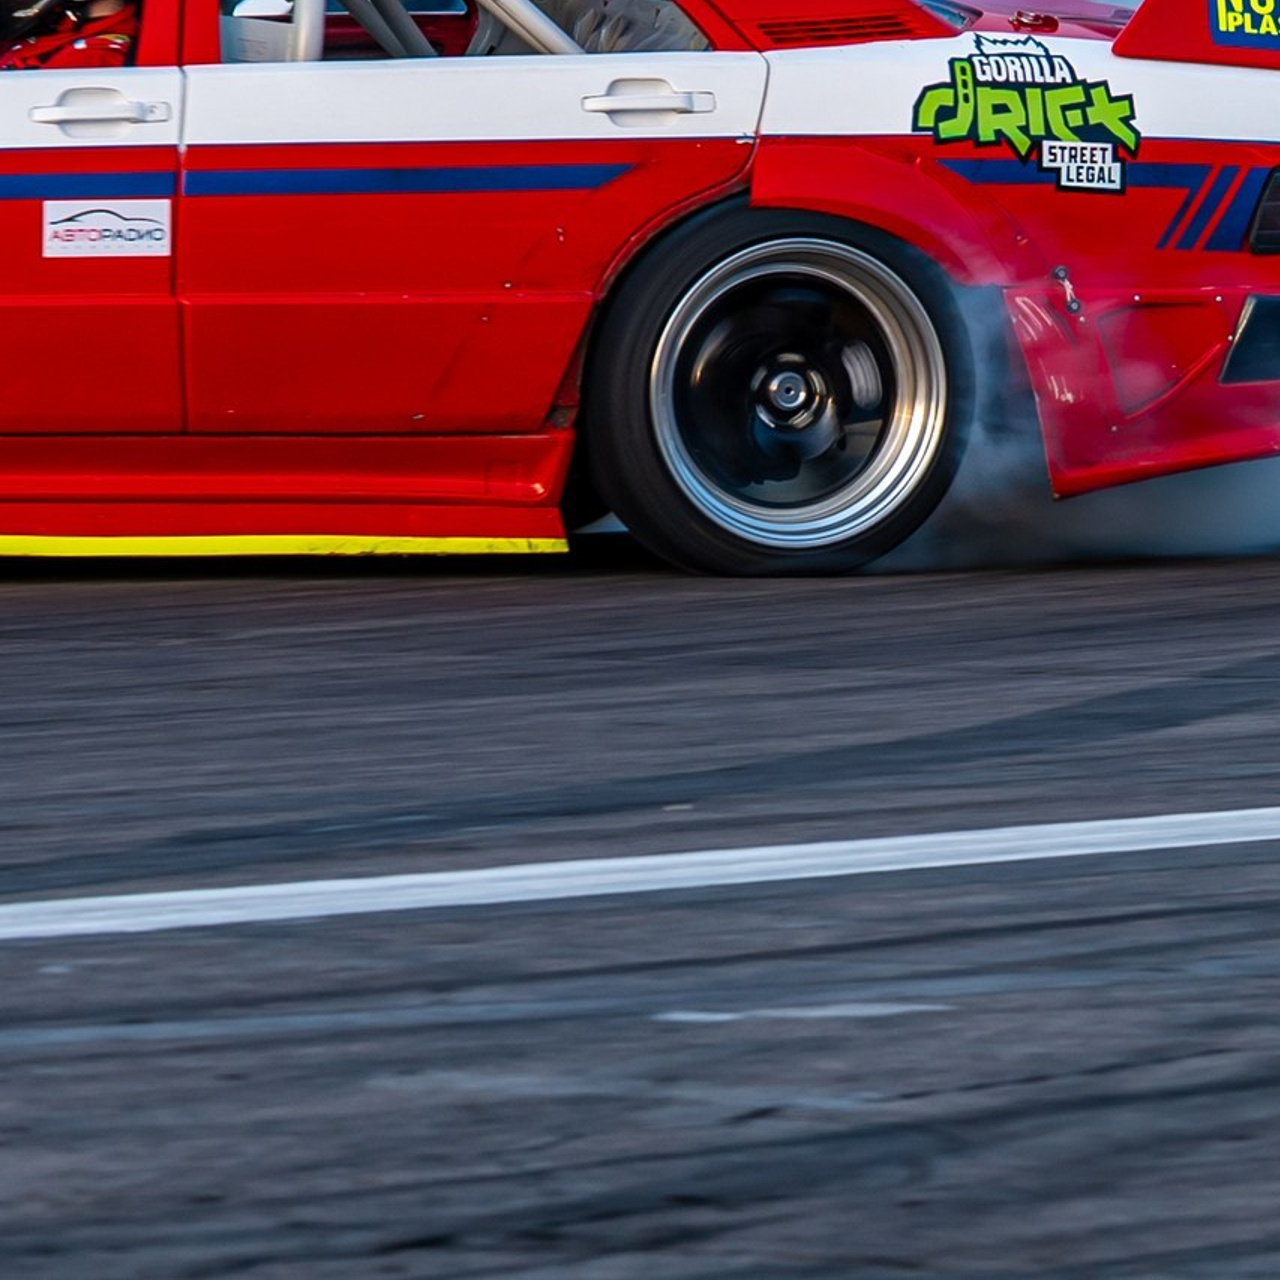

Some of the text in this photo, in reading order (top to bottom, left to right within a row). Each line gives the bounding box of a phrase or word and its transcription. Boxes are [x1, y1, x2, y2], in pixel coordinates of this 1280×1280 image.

[1227, 11, 1280, 36] PLA
[972, 56, 1073, 83] GORILLA
[1048, 145, 1109, 164] STREET
[1066, 166, 1117, 184] LEGAL
